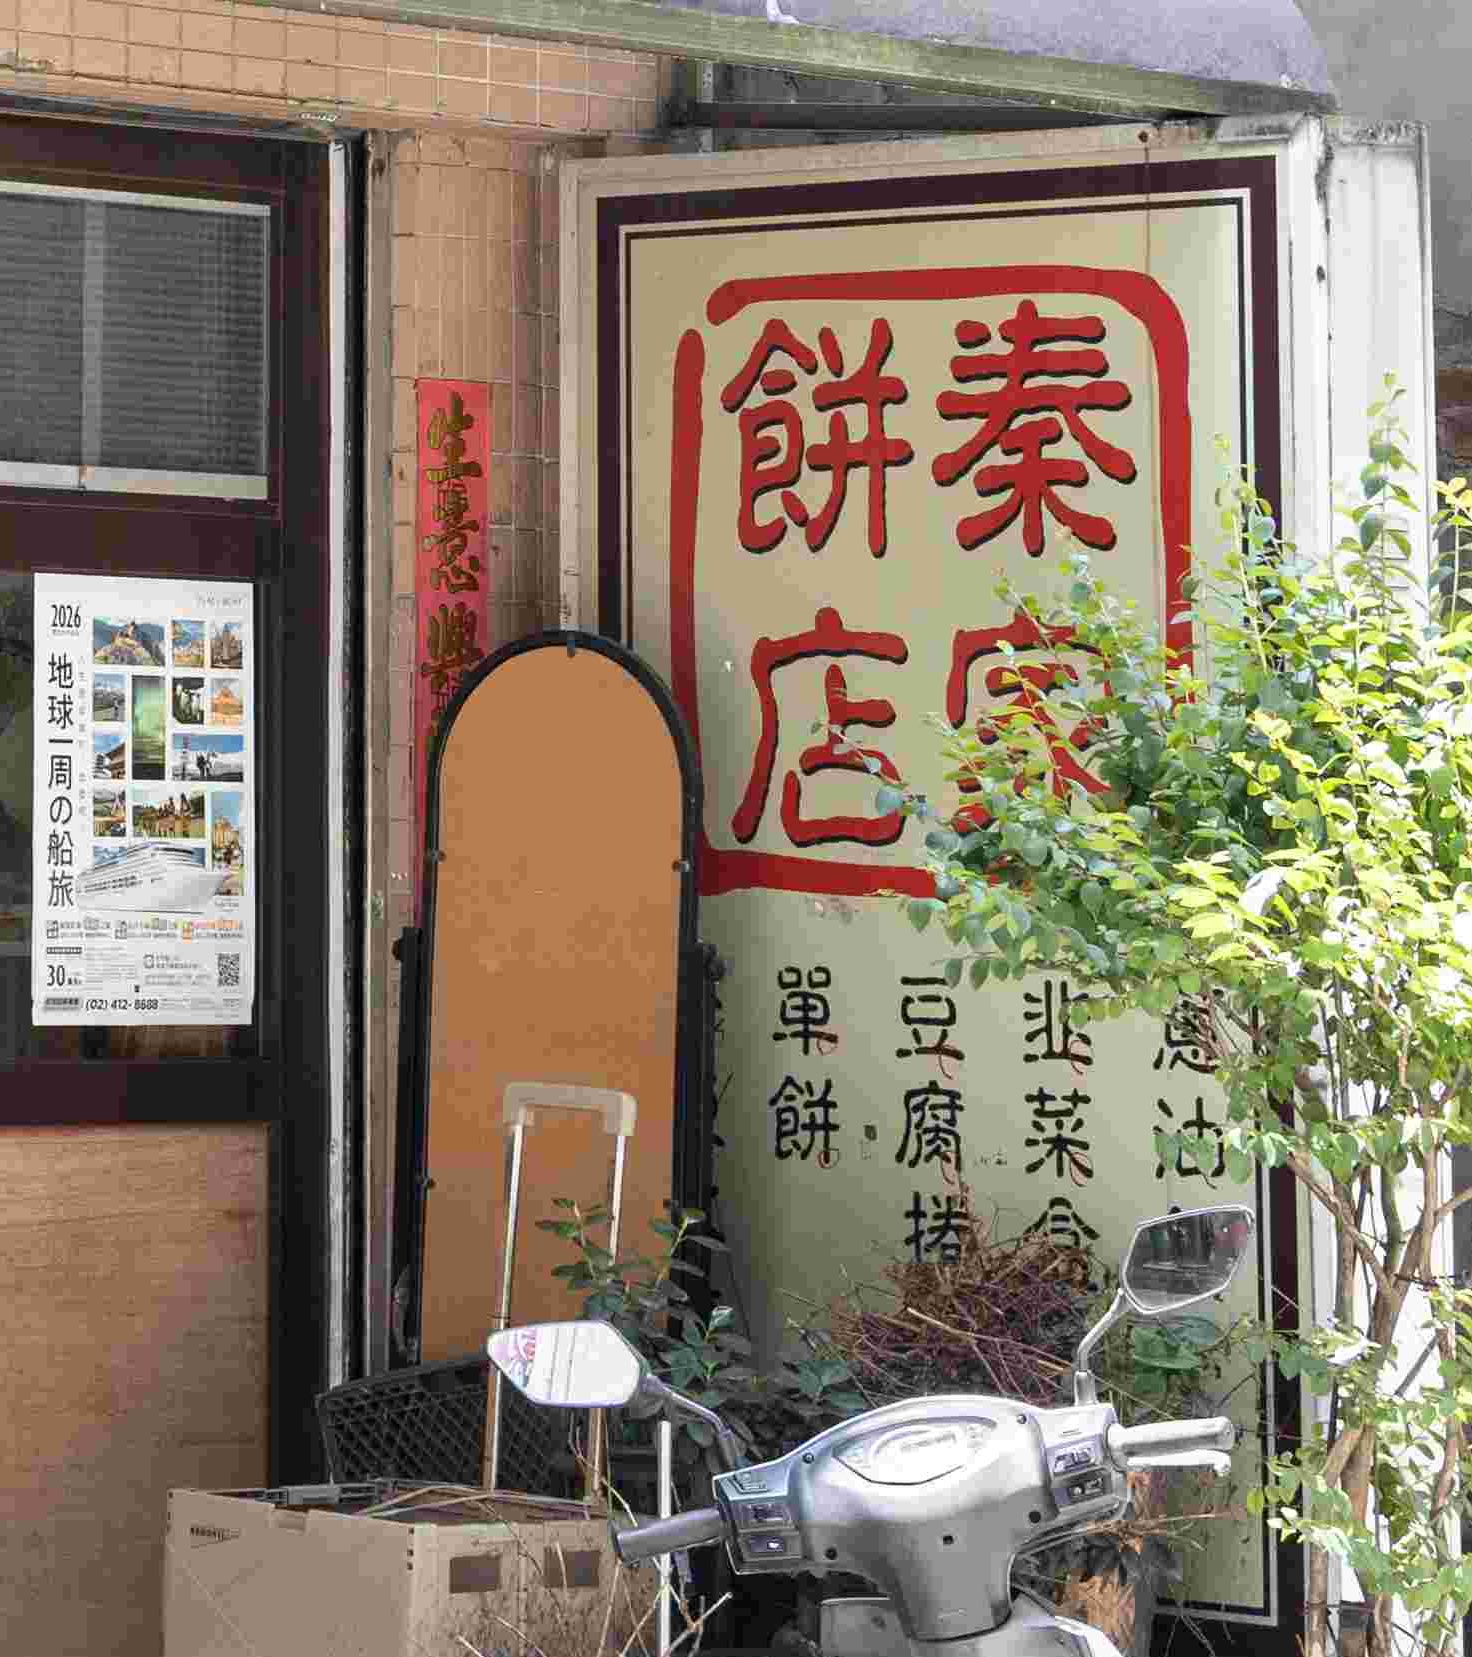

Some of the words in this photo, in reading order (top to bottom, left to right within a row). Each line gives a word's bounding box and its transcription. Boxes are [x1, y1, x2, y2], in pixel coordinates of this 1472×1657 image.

[51, 603, 81, 628] 2026
[421, 389, 485, 718] 生意興
[47, 652, 74, 907] 地球一周の船旅
[46, 964, 66, 987] 30
[767, 966, 840, 1165] 單餅
